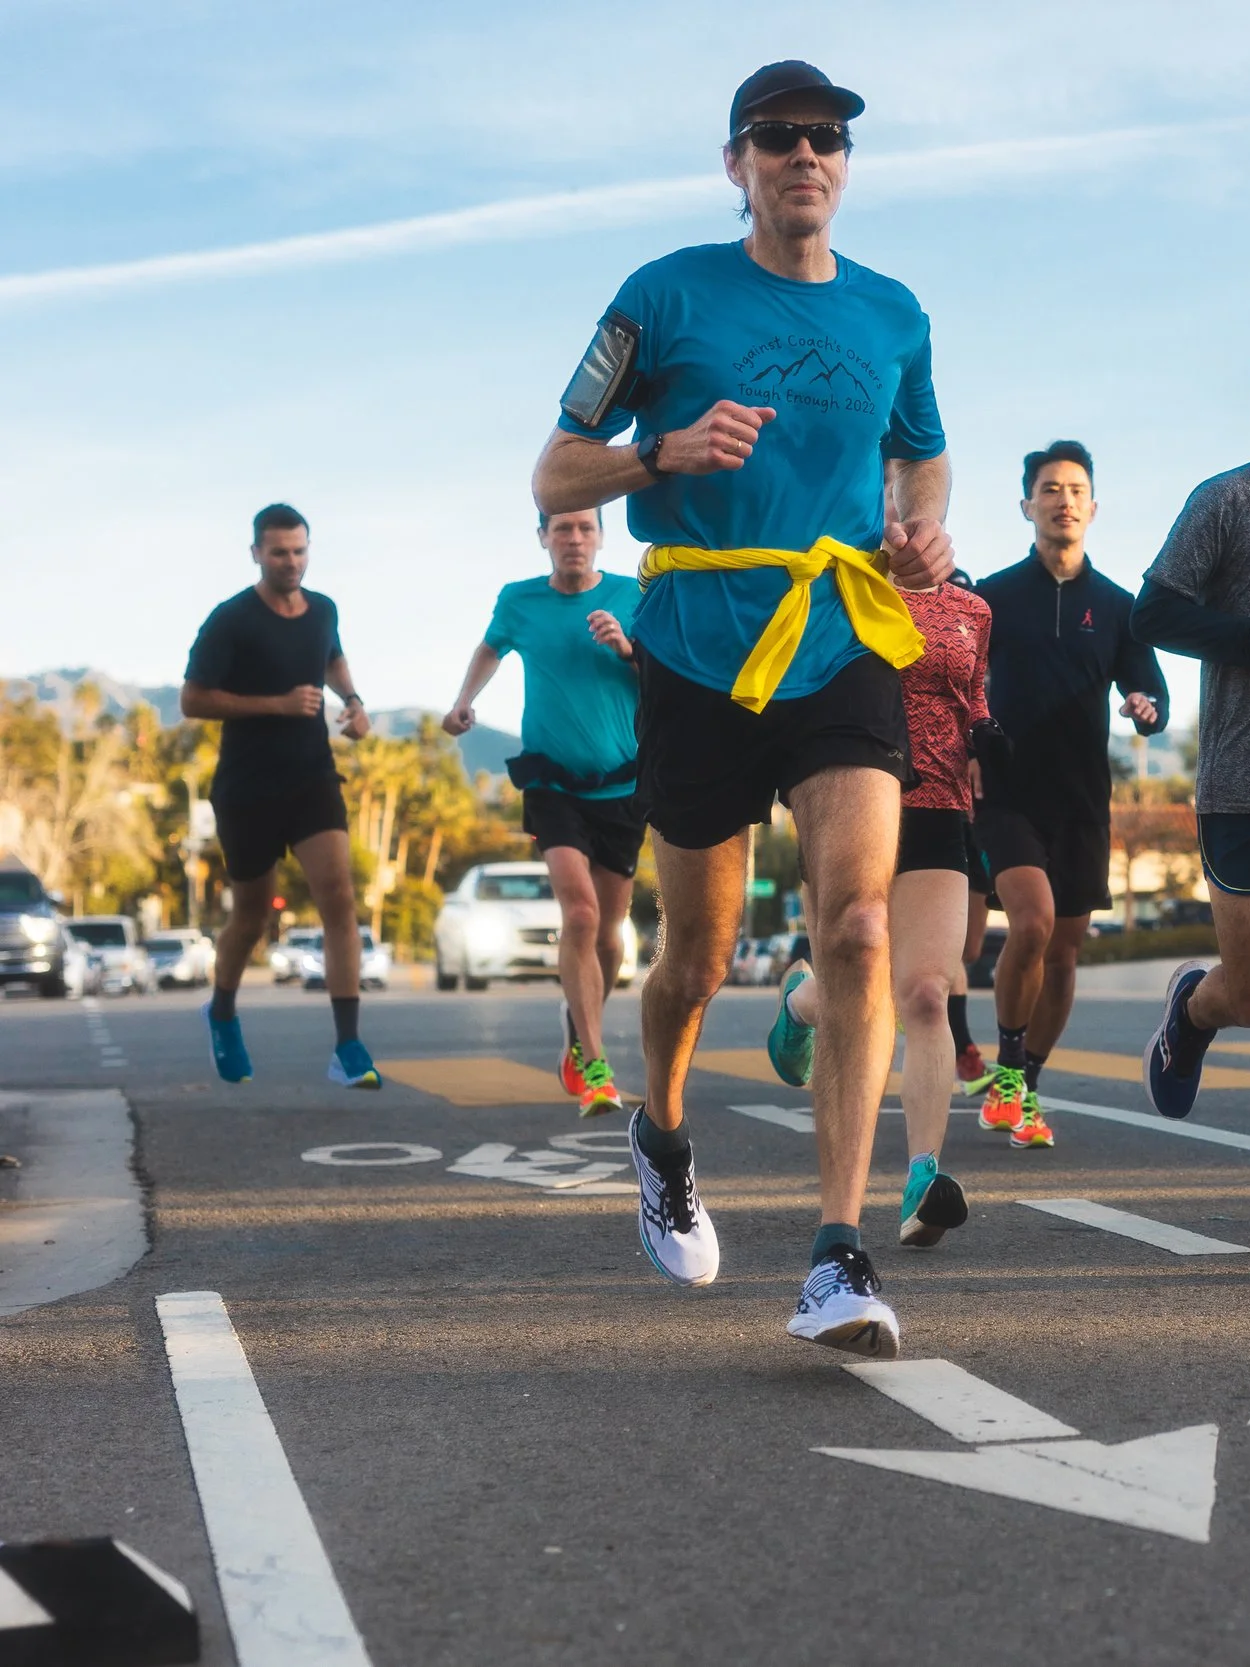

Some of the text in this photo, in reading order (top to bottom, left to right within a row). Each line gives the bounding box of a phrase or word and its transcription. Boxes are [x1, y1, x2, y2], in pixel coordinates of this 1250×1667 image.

[732, 335, 883, 389] Against Coach's Orders
[737, 383, 875, 415] Tough Enough 2022
